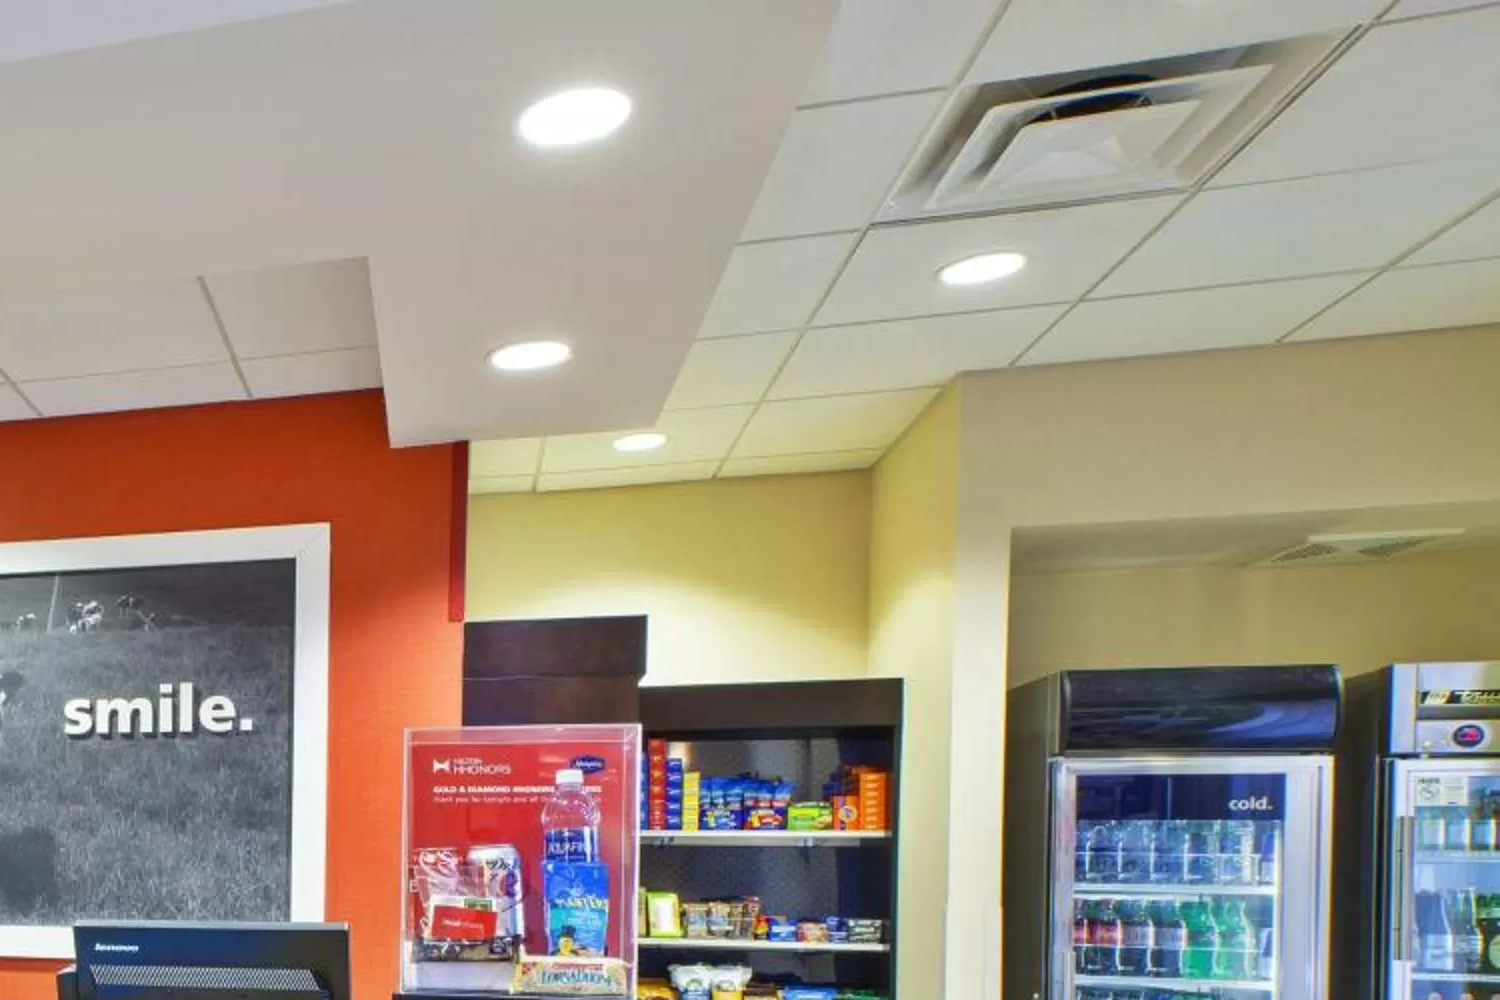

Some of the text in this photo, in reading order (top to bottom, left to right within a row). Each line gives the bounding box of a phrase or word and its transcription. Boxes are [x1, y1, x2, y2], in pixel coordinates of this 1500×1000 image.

[63, 682, 253, 736] smile.
[453, 764, 512, 775] HHONORS
[1228, 796, 1274, 811] cold.
